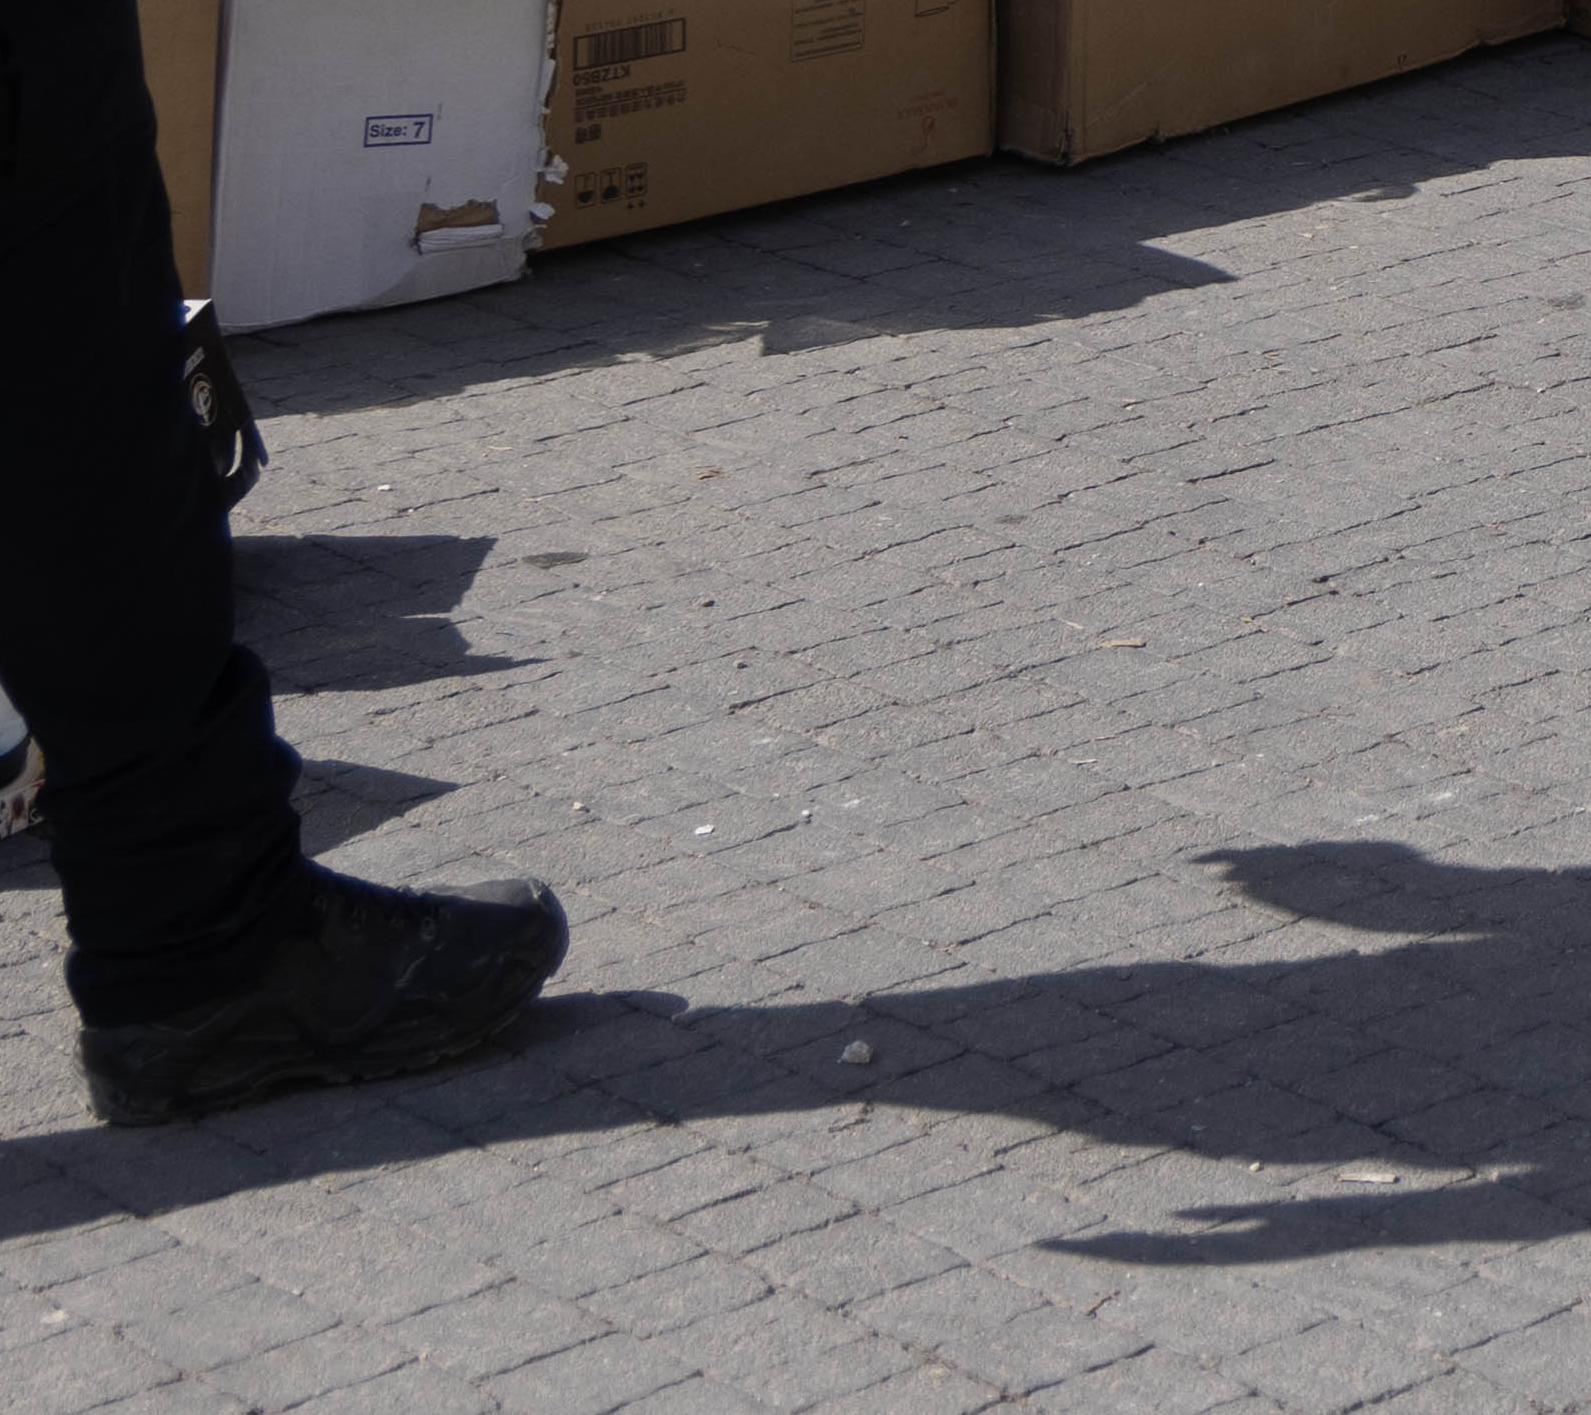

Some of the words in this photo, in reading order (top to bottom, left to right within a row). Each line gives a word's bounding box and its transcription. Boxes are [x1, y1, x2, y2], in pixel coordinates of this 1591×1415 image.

[572, 64, 632, 87] KTZB50
[369, 123, 408, 139] Size:
[413, 121, 426, 139] 7
